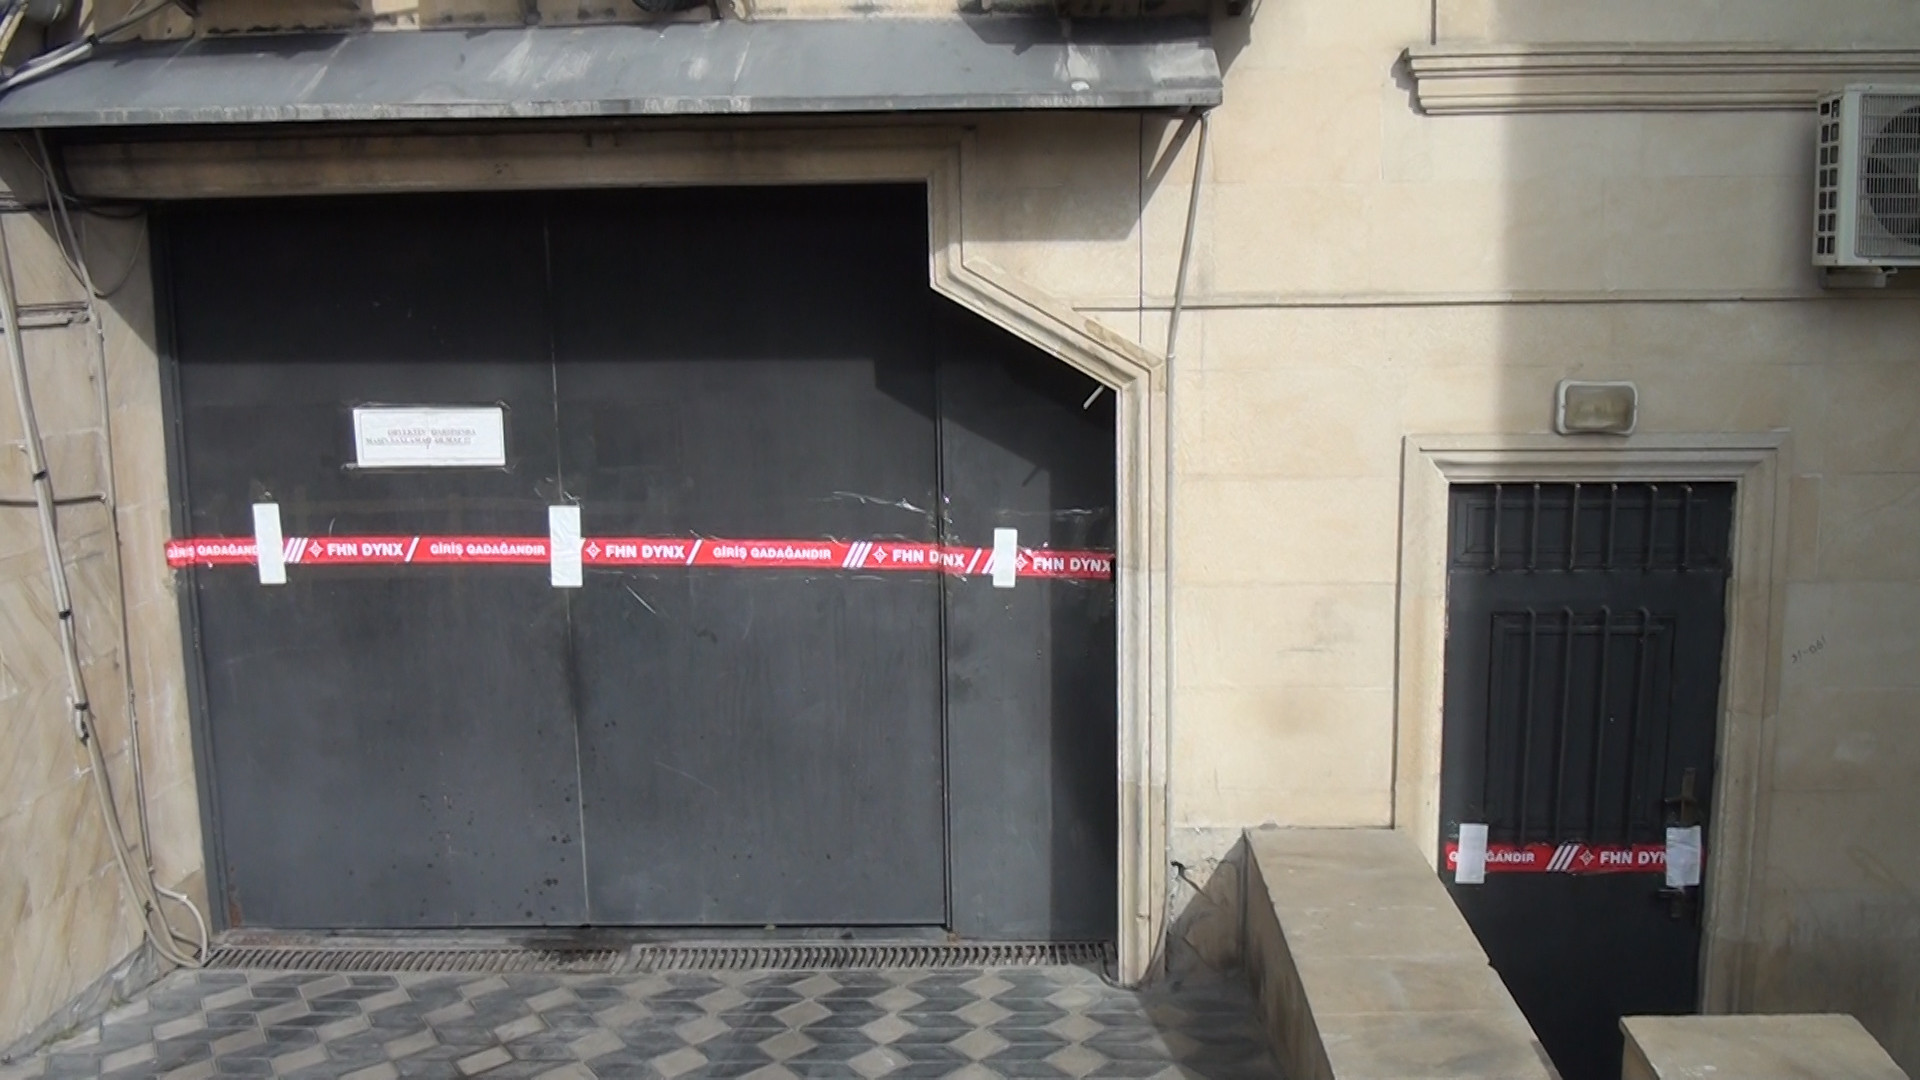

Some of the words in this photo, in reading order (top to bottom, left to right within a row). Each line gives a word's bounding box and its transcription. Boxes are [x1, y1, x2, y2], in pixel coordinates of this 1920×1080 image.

[197, 543, 260, 556] QADAĞAND
[327, 543, 357, 556] FHN
[362, 543, 404, 557] DYNX
[430, 541, 464, 556] GİRİŞ
[466, 541, 546, 556] QADAĞANDIR
[605, 545, 637, 558] FHN
[642, 545, 686, 559] DYNX
[712, 545, 748, 560] GİRİŞ
[750, 546, 832, 560] QADAĞANDIR
[892, 549, 925, 563] FHN
[1032, 556, 1065, 572] FHN
[1069, 557, 1111, 572] DYNX
[1600, 851, 1633, 864] FHN
[1638, 851, 1667, 865] DYN
